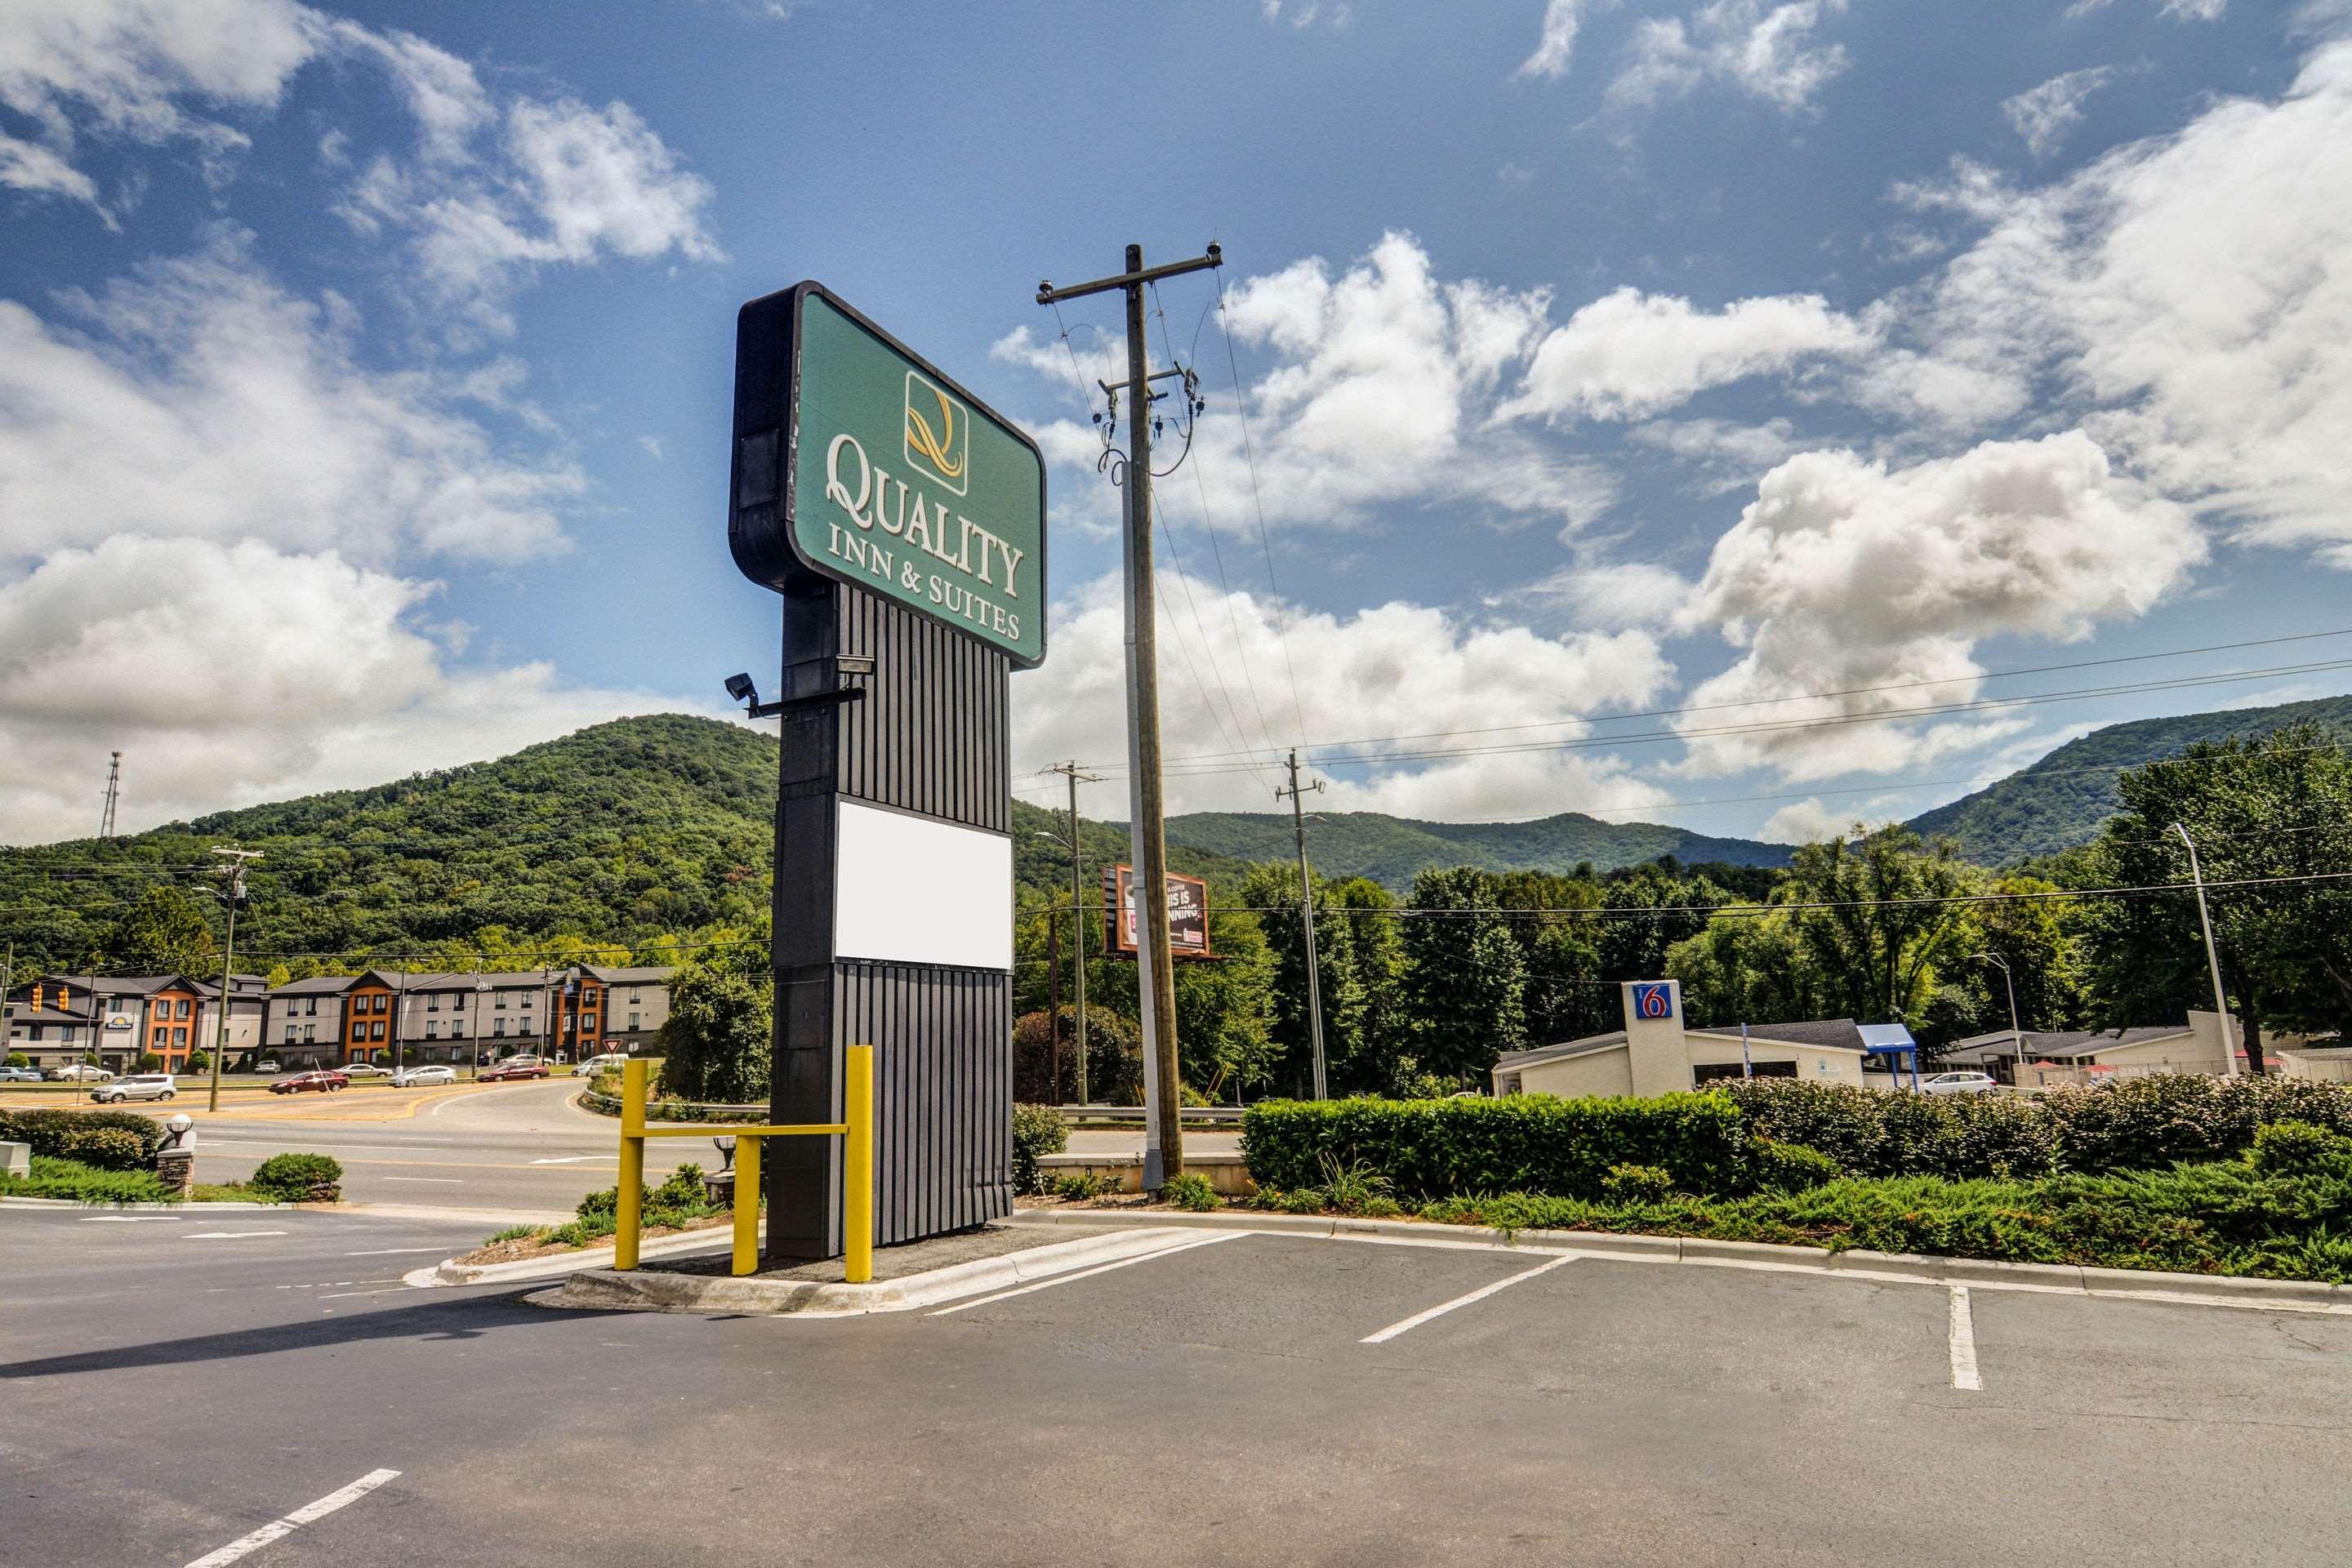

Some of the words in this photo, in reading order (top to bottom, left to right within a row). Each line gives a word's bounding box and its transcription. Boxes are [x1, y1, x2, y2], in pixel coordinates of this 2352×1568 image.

[826, 434, 1023, 598] QUALITY
[828, 523, 894, 581] INN
[901, 561, 921, 594] &
[929, 575, 1020, 640] SUITES
[1169, 903, 1197, 921] NNING
[1181, 891, 1190, 905] IS
[1643, 986, 1666, 1018] 6
